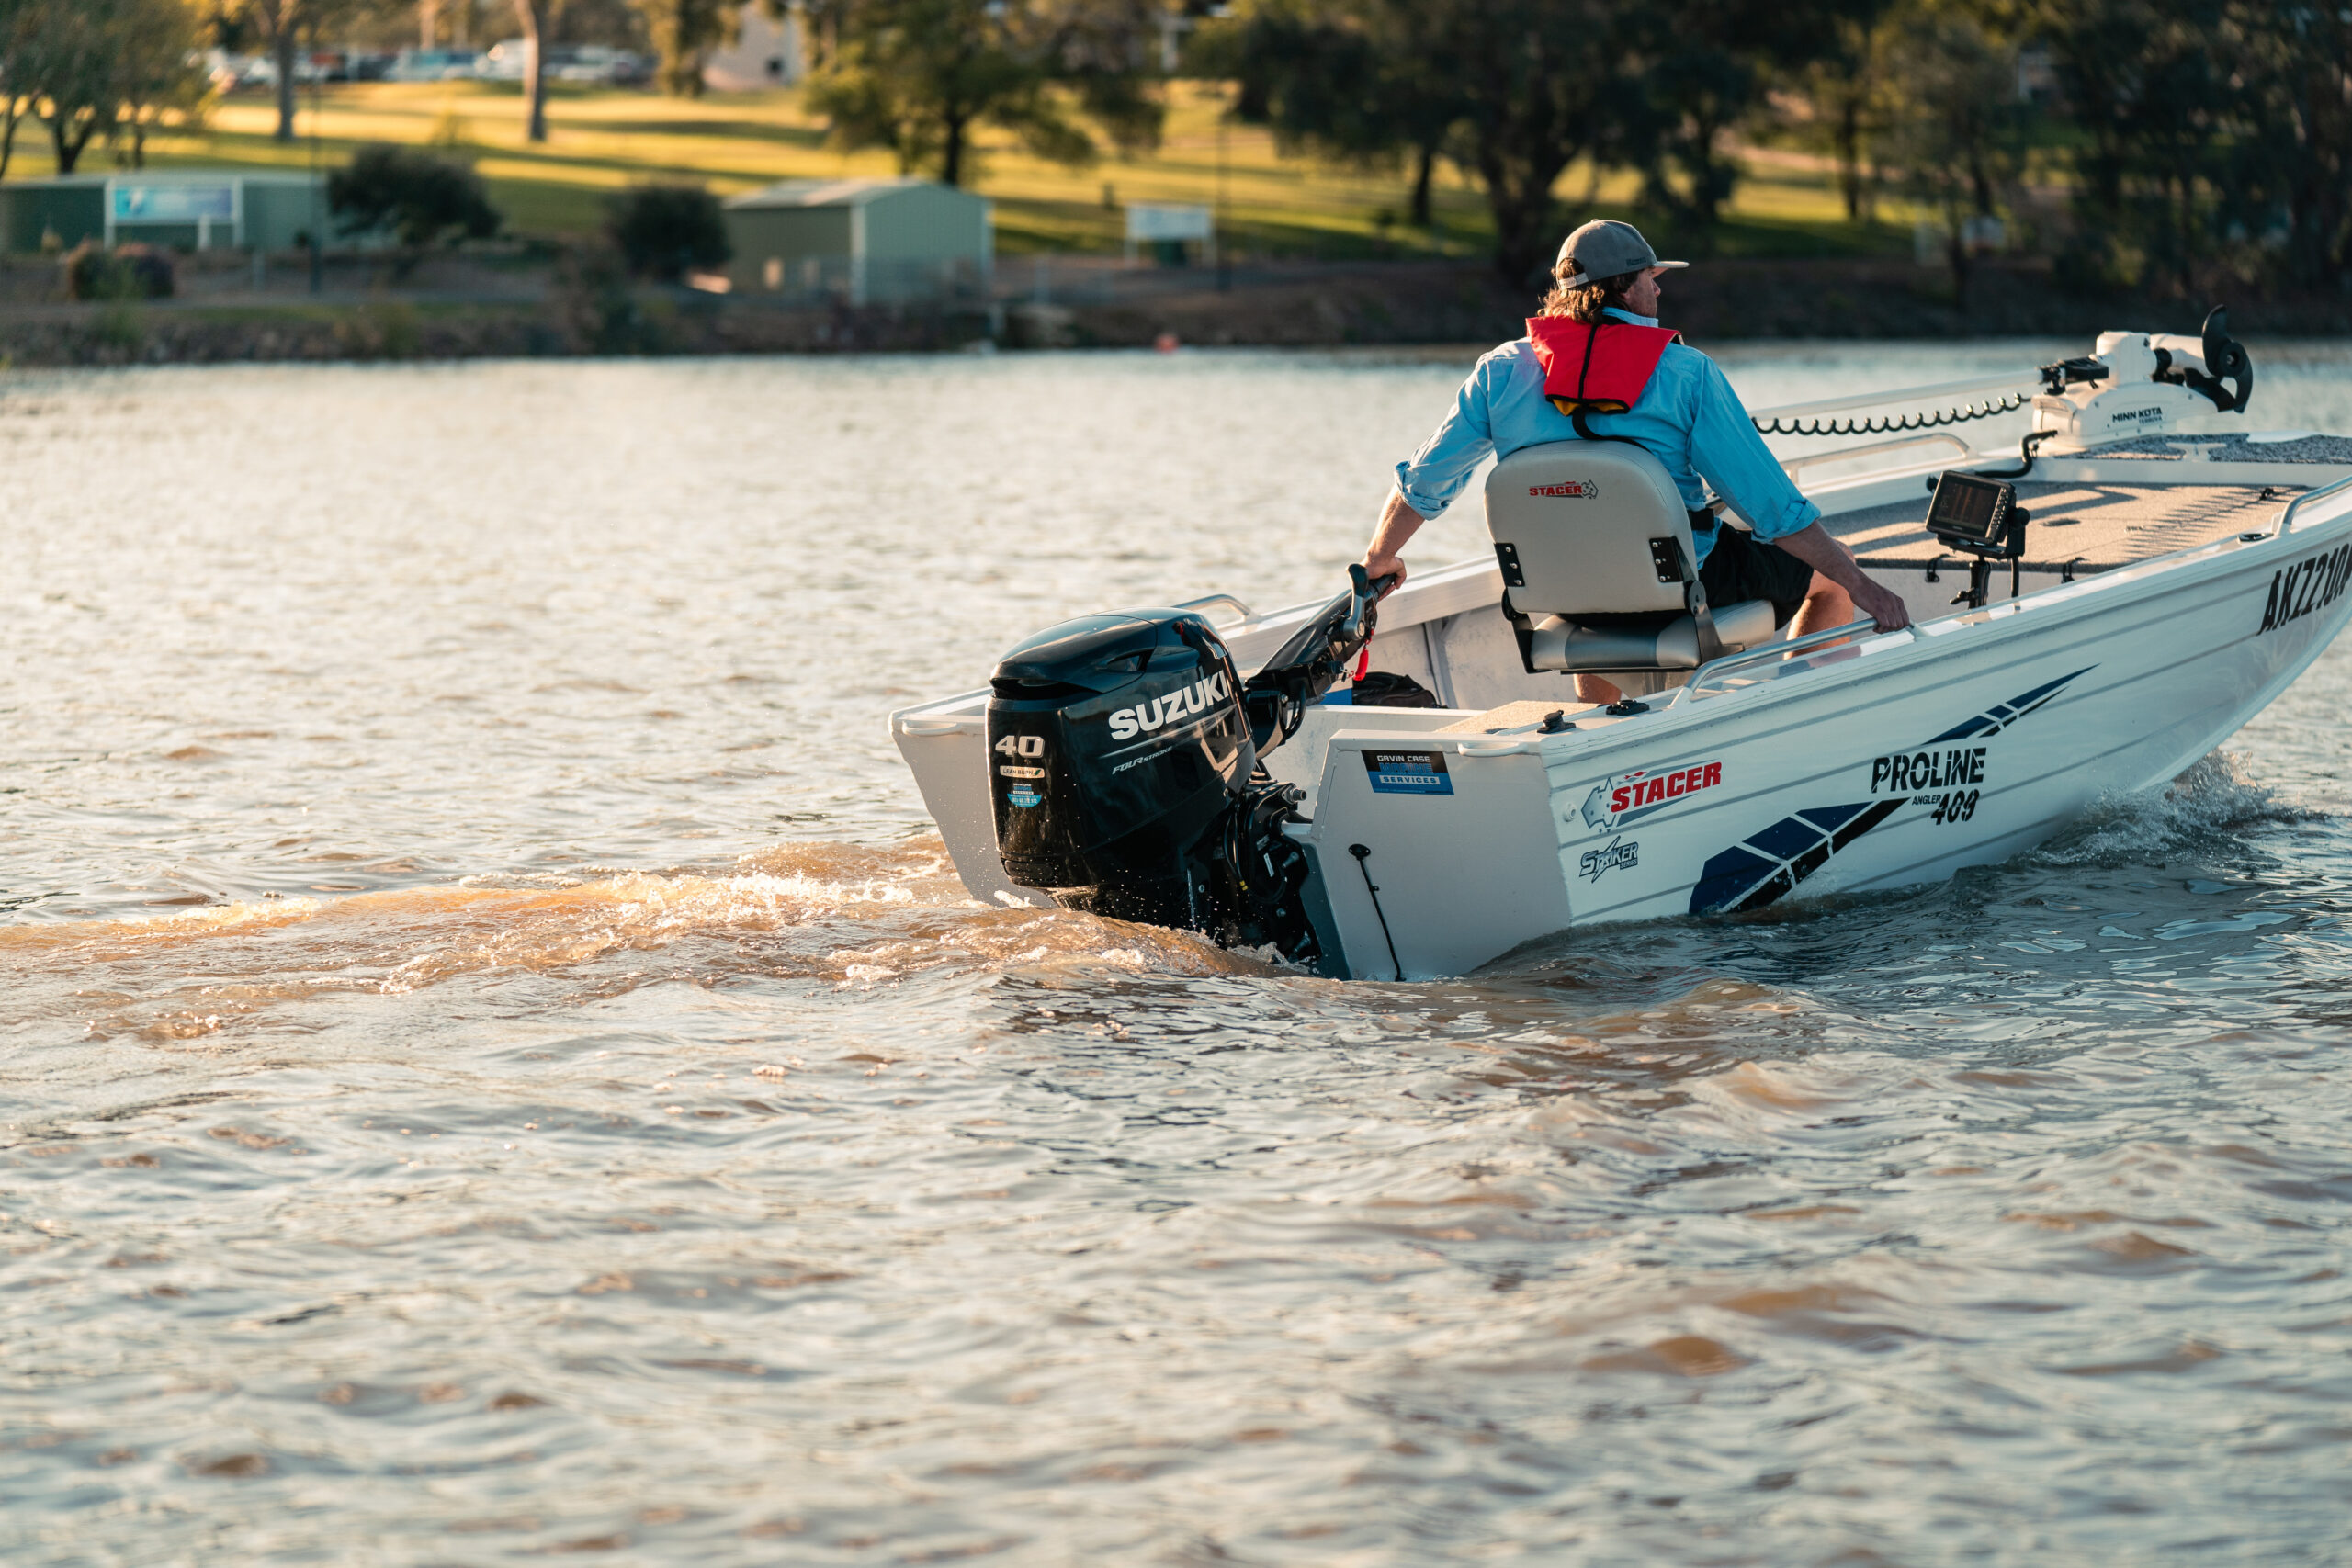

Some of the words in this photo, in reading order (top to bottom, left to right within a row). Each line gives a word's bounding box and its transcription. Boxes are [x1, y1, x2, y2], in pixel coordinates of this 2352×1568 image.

[2112, 410, 2136, 423] MINN
[2139, 406, 2163, 418] KOTA
[1529, 485, 1582, 496] STACER
[1108, 670, 1229, 740] SUZUKI
[995, 735, 1045, 758] 40
[1611, 761, 1722, 813] STACER
[1871, 747, 1986, 794] PROLINE
[1912, 795, 1942, 805] ANGLER
[1930, 789, 1980, 825] 409
[1579, 840, 1639, 879] STRIKER
